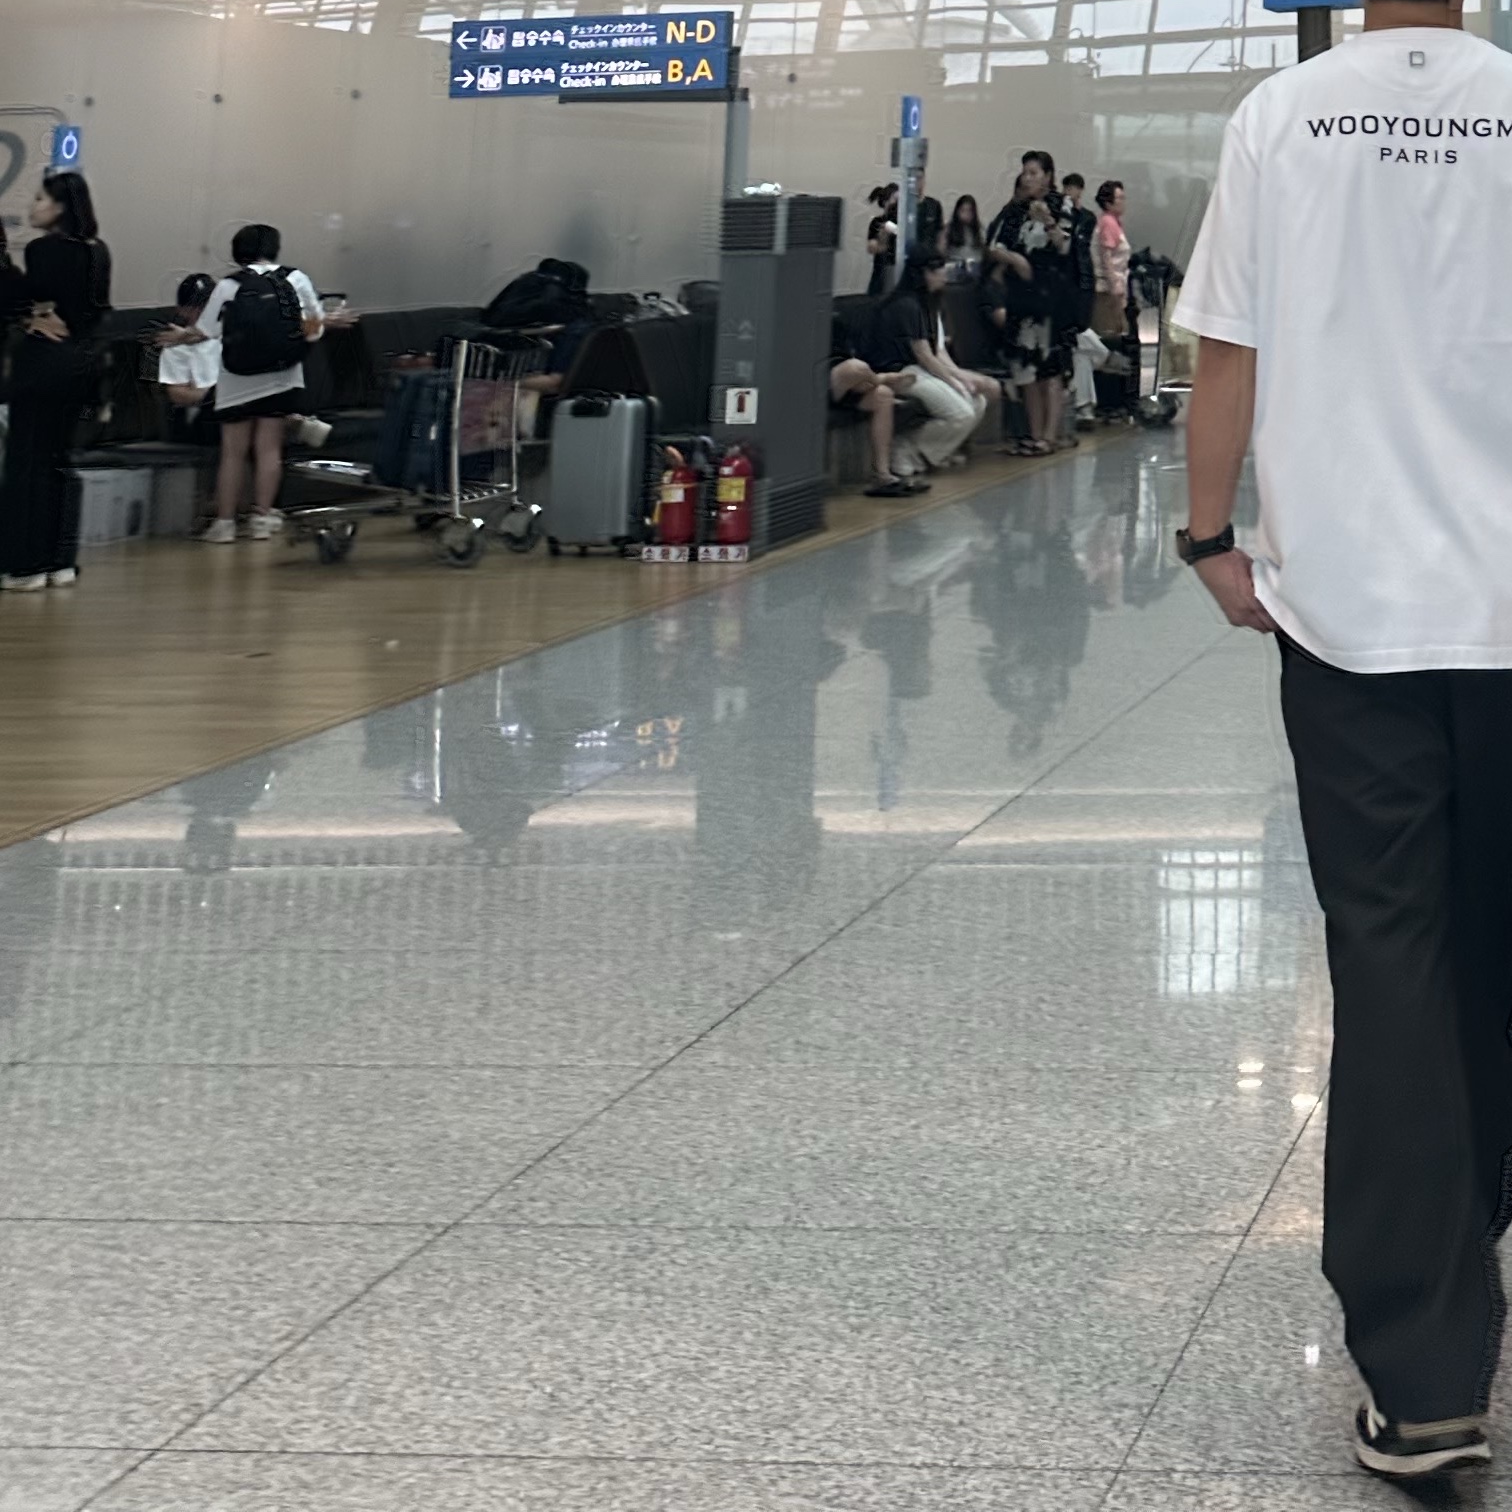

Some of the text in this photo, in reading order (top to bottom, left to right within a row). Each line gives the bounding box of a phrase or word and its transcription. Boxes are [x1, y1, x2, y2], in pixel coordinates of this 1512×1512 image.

[666, 20, 716, 44] N-D
[568, 37, 609, 50] Check-in
[666, 59, 714, 86] B,A
[559, 75, 607, 89] Check-in
[1379, 146, 1459, 164] PARIS
